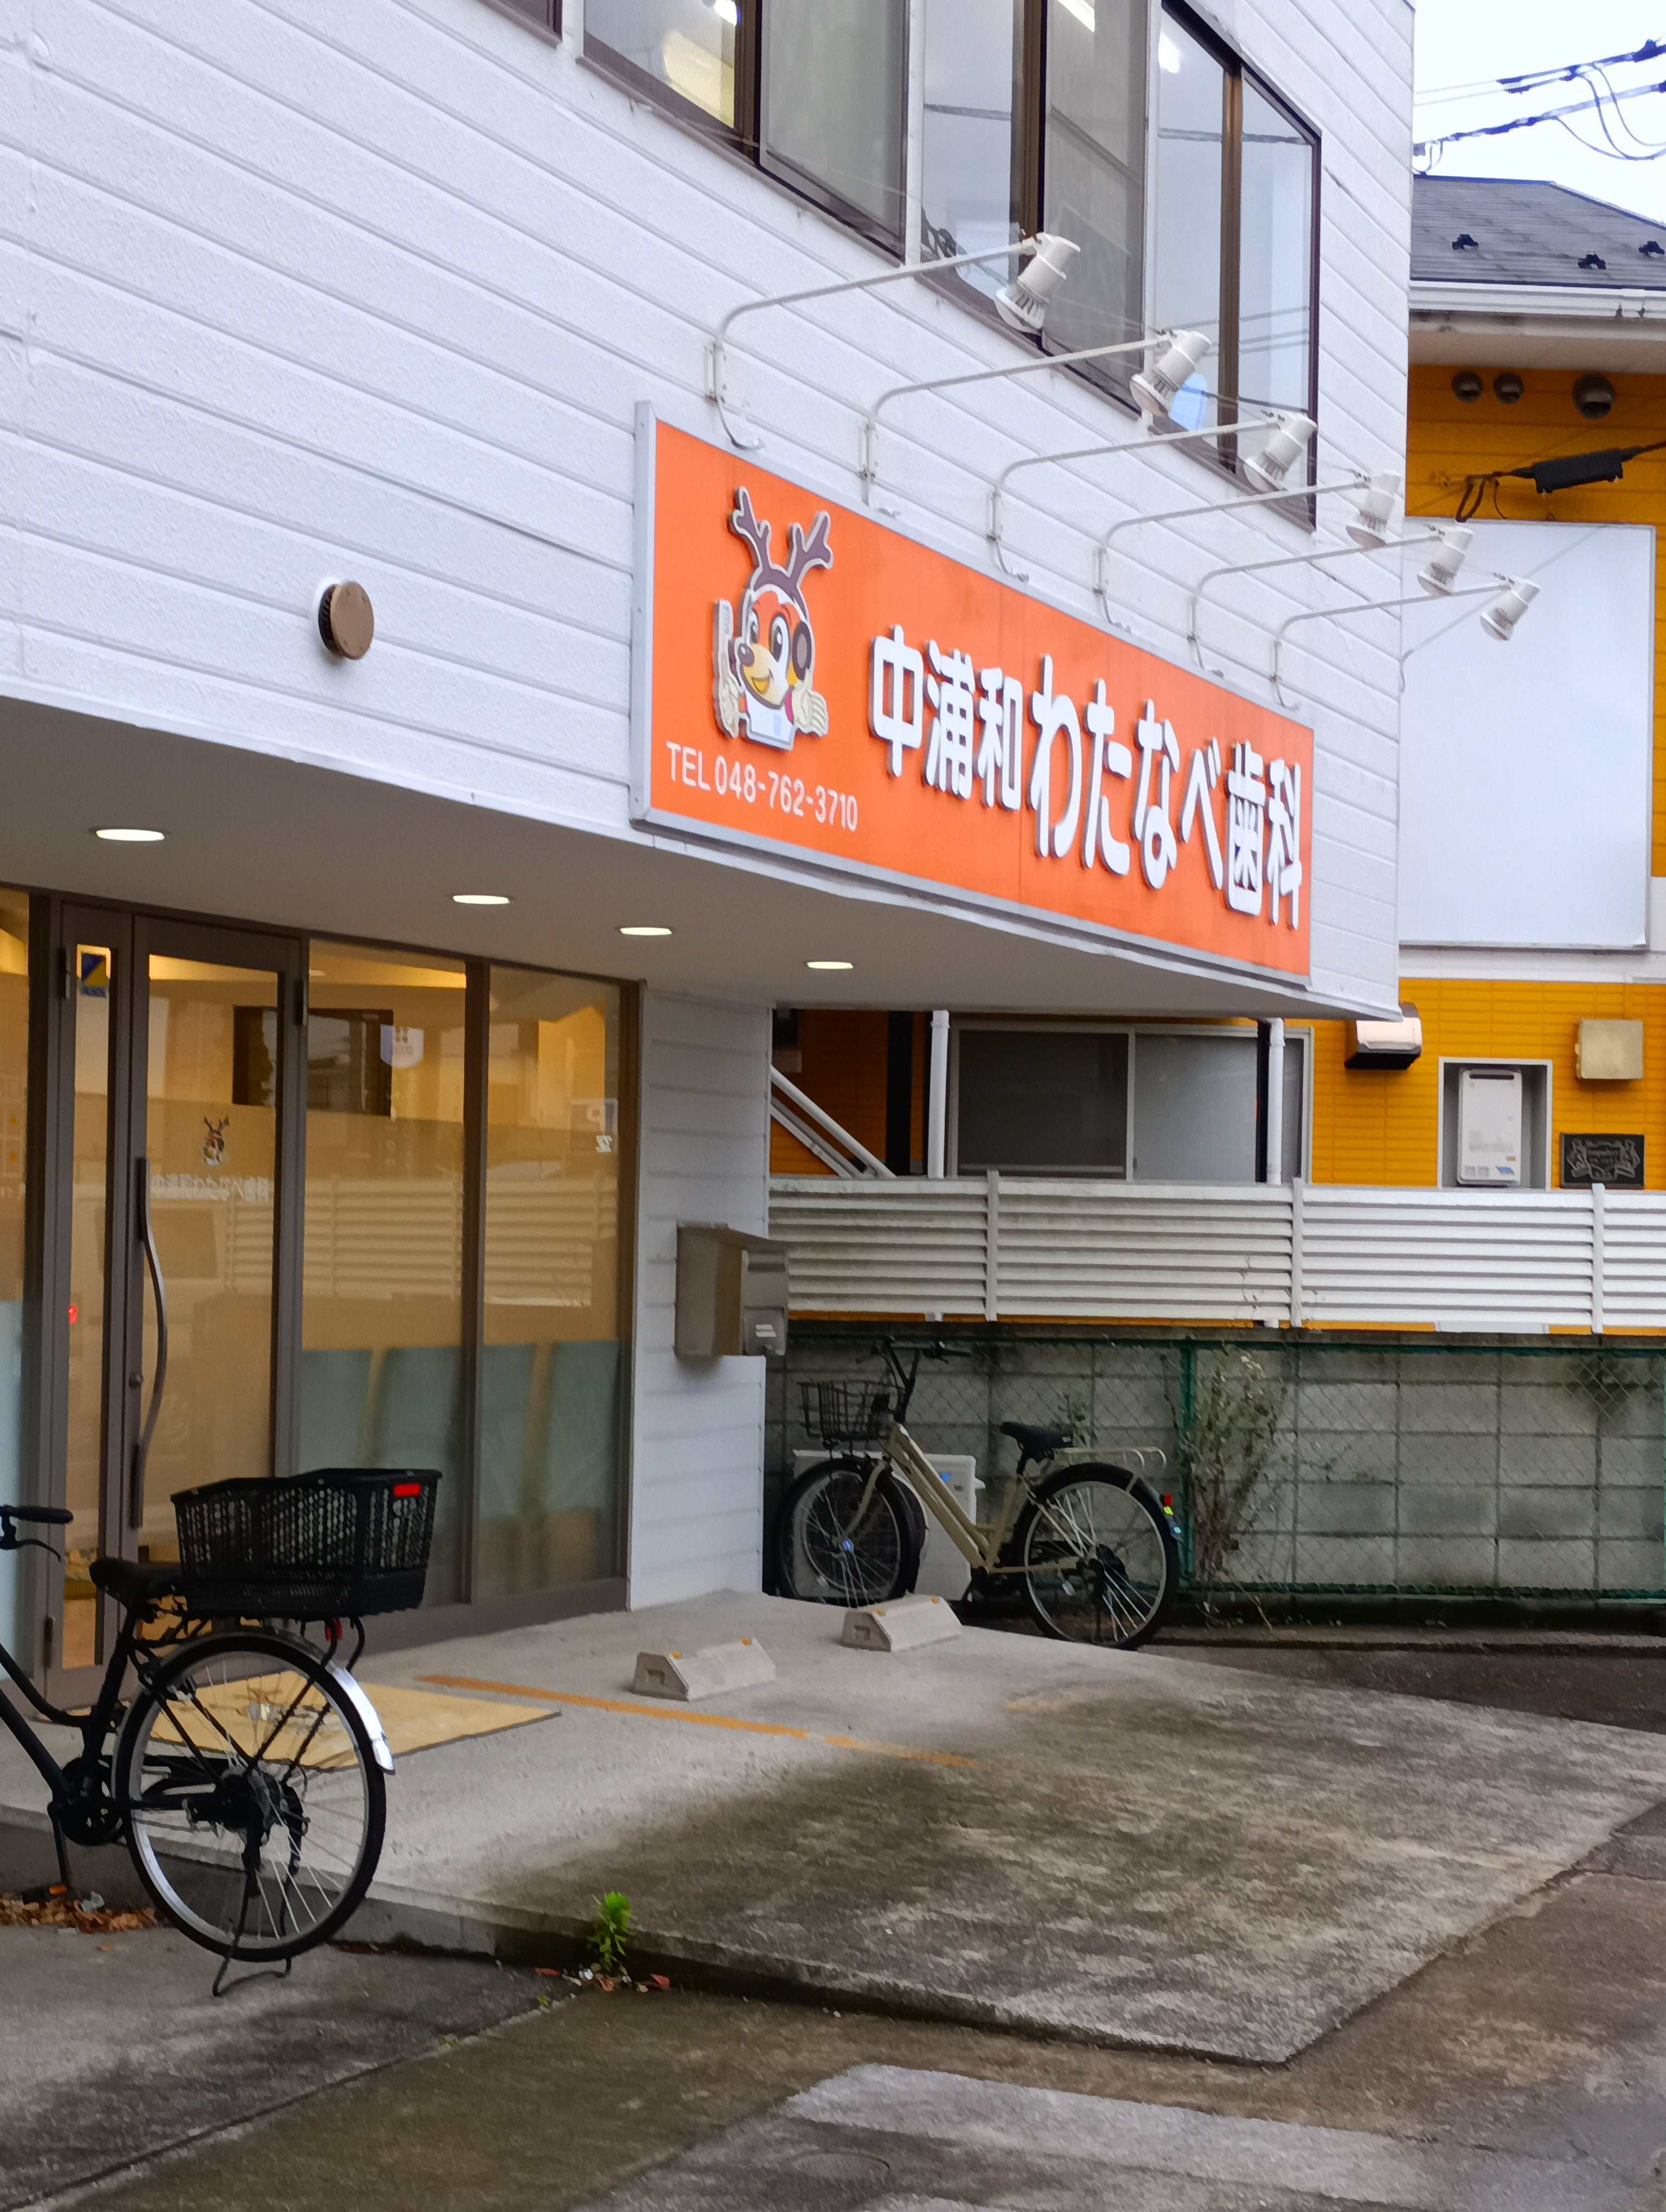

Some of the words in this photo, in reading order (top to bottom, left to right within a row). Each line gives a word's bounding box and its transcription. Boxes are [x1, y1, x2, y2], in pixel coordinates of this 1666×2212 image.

[665, 741, 711, 791] TEL
[715, 755, 858, 832] 048-762-3710
[868, 625, 1303, 930] 中浦和わたなべ歯科
